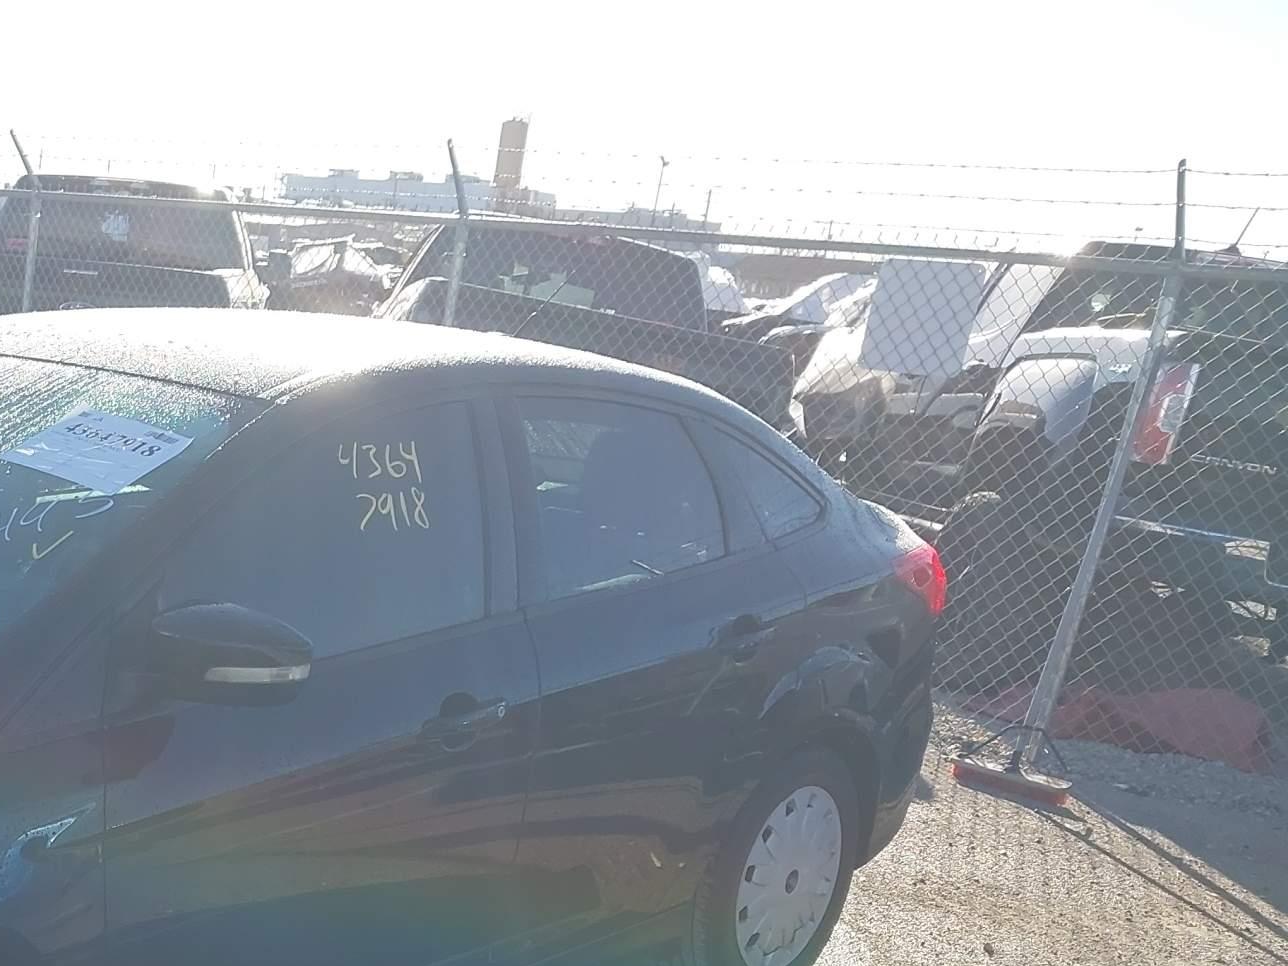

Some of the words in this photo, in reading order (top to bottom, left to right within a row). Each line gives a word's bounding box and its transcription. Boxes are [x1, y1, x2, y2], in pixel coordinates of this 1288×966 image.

[65, 422, 162, 458] 43647918
[337, 440, 423, 484] 4364
[354, 485, 430, 532] 7918
